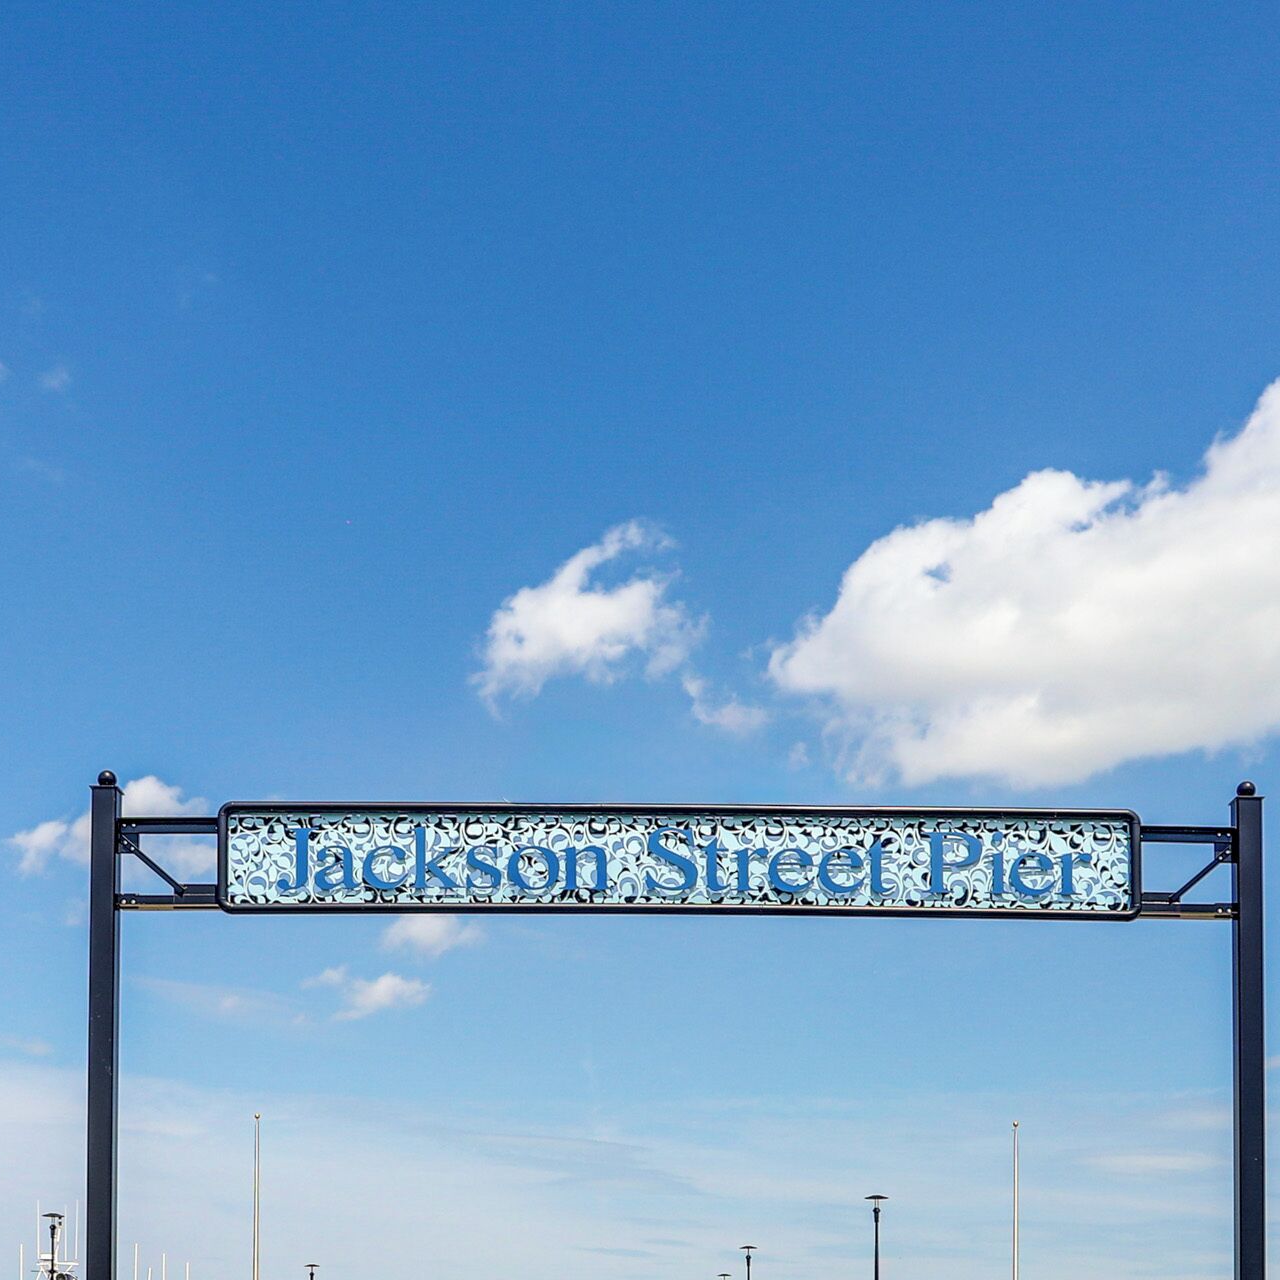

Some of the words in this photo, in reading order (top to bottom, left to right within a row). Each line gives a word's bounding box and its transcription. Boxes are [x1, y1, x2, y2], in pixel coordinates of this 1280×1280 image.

[276, 826, 609, 891] Jackson
[645, 826, 898, 896] Street
[925, 829, 1092, 897] Pier
